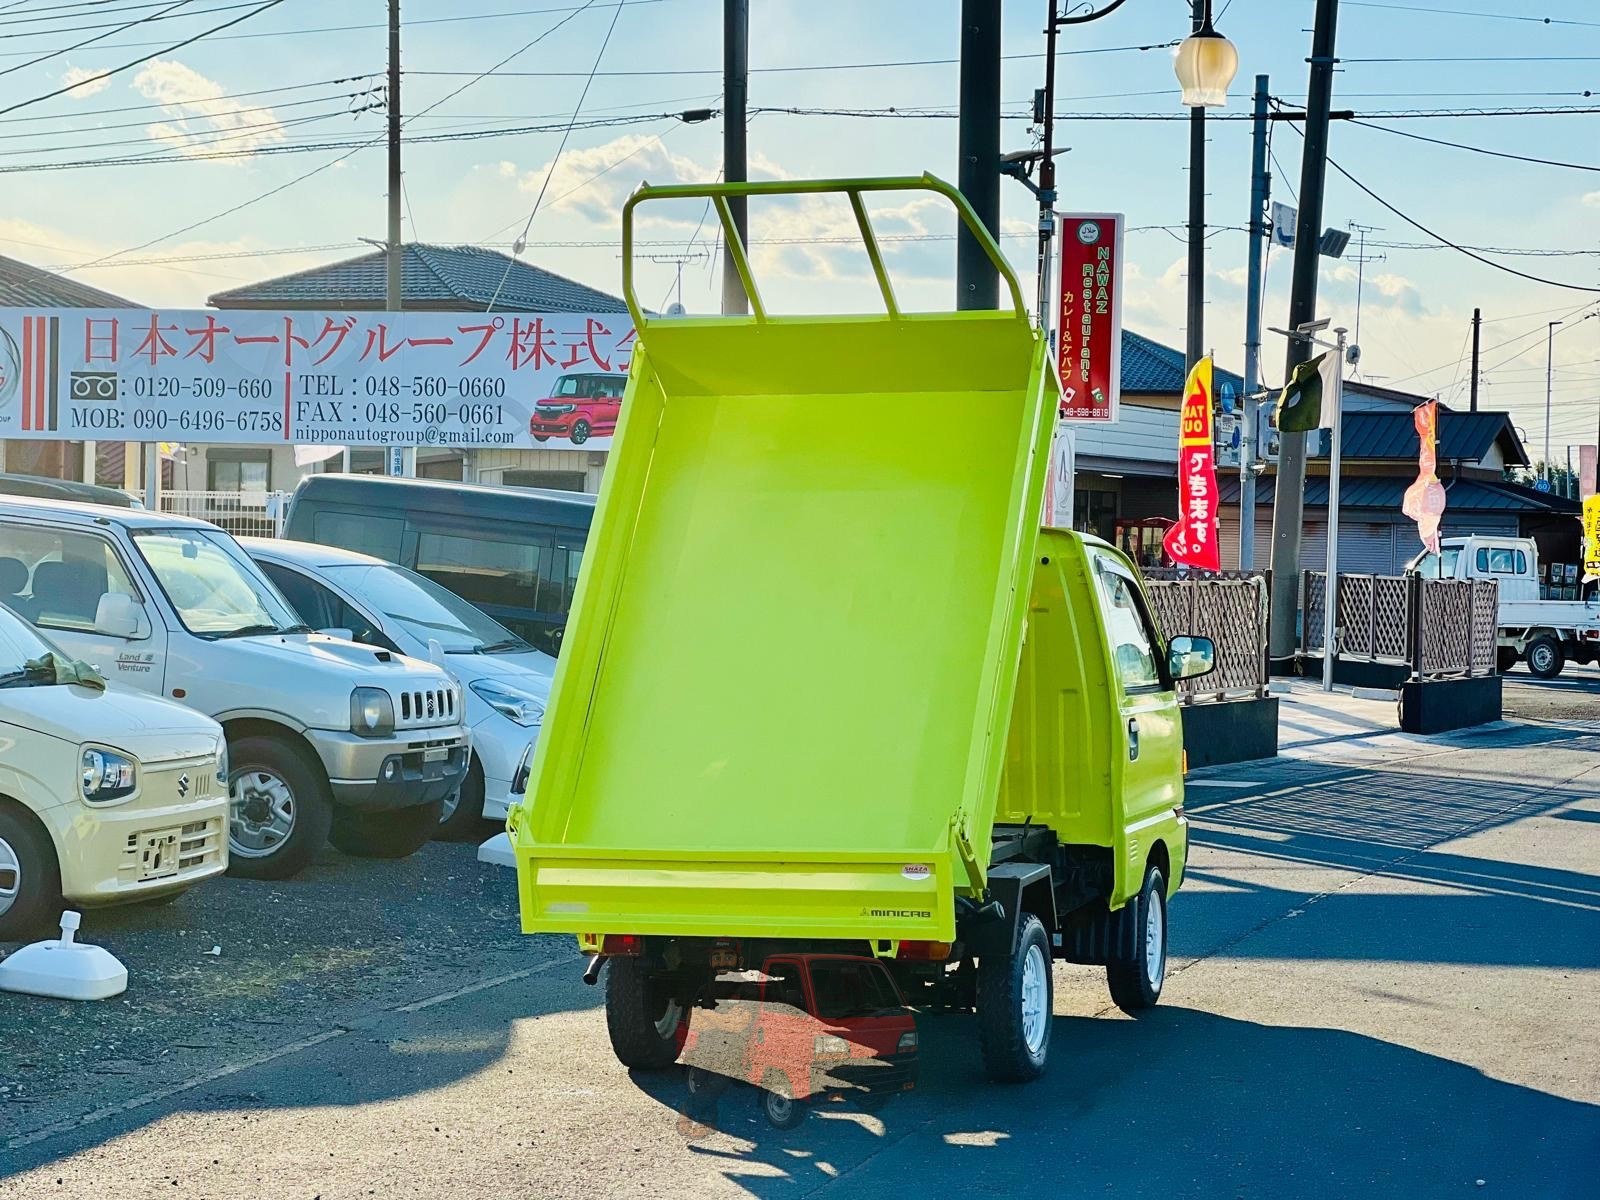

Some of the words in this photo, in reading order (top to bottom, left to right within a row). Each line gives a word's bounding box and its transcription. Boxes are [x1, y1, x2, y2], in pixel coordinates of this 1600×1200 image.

[1096, 247, 1109, 314] NAWAZ
[1080, 264, 1094, 382] Restaurant
[134, 377, 272, 399] 0120-509-660
[365, 376, 506, 398] 048-560-0660
[71, 408, 126, 429] MOB:
[133, 409, 282, 432] 090-6496-6758
[365, 403, 503, 425] 048-560-0661
[295, 427, 514, 445] nipponautogroup@gmail.com
[118, 663, 150, 672] Venture
[119, 653, 141, 661] Land
